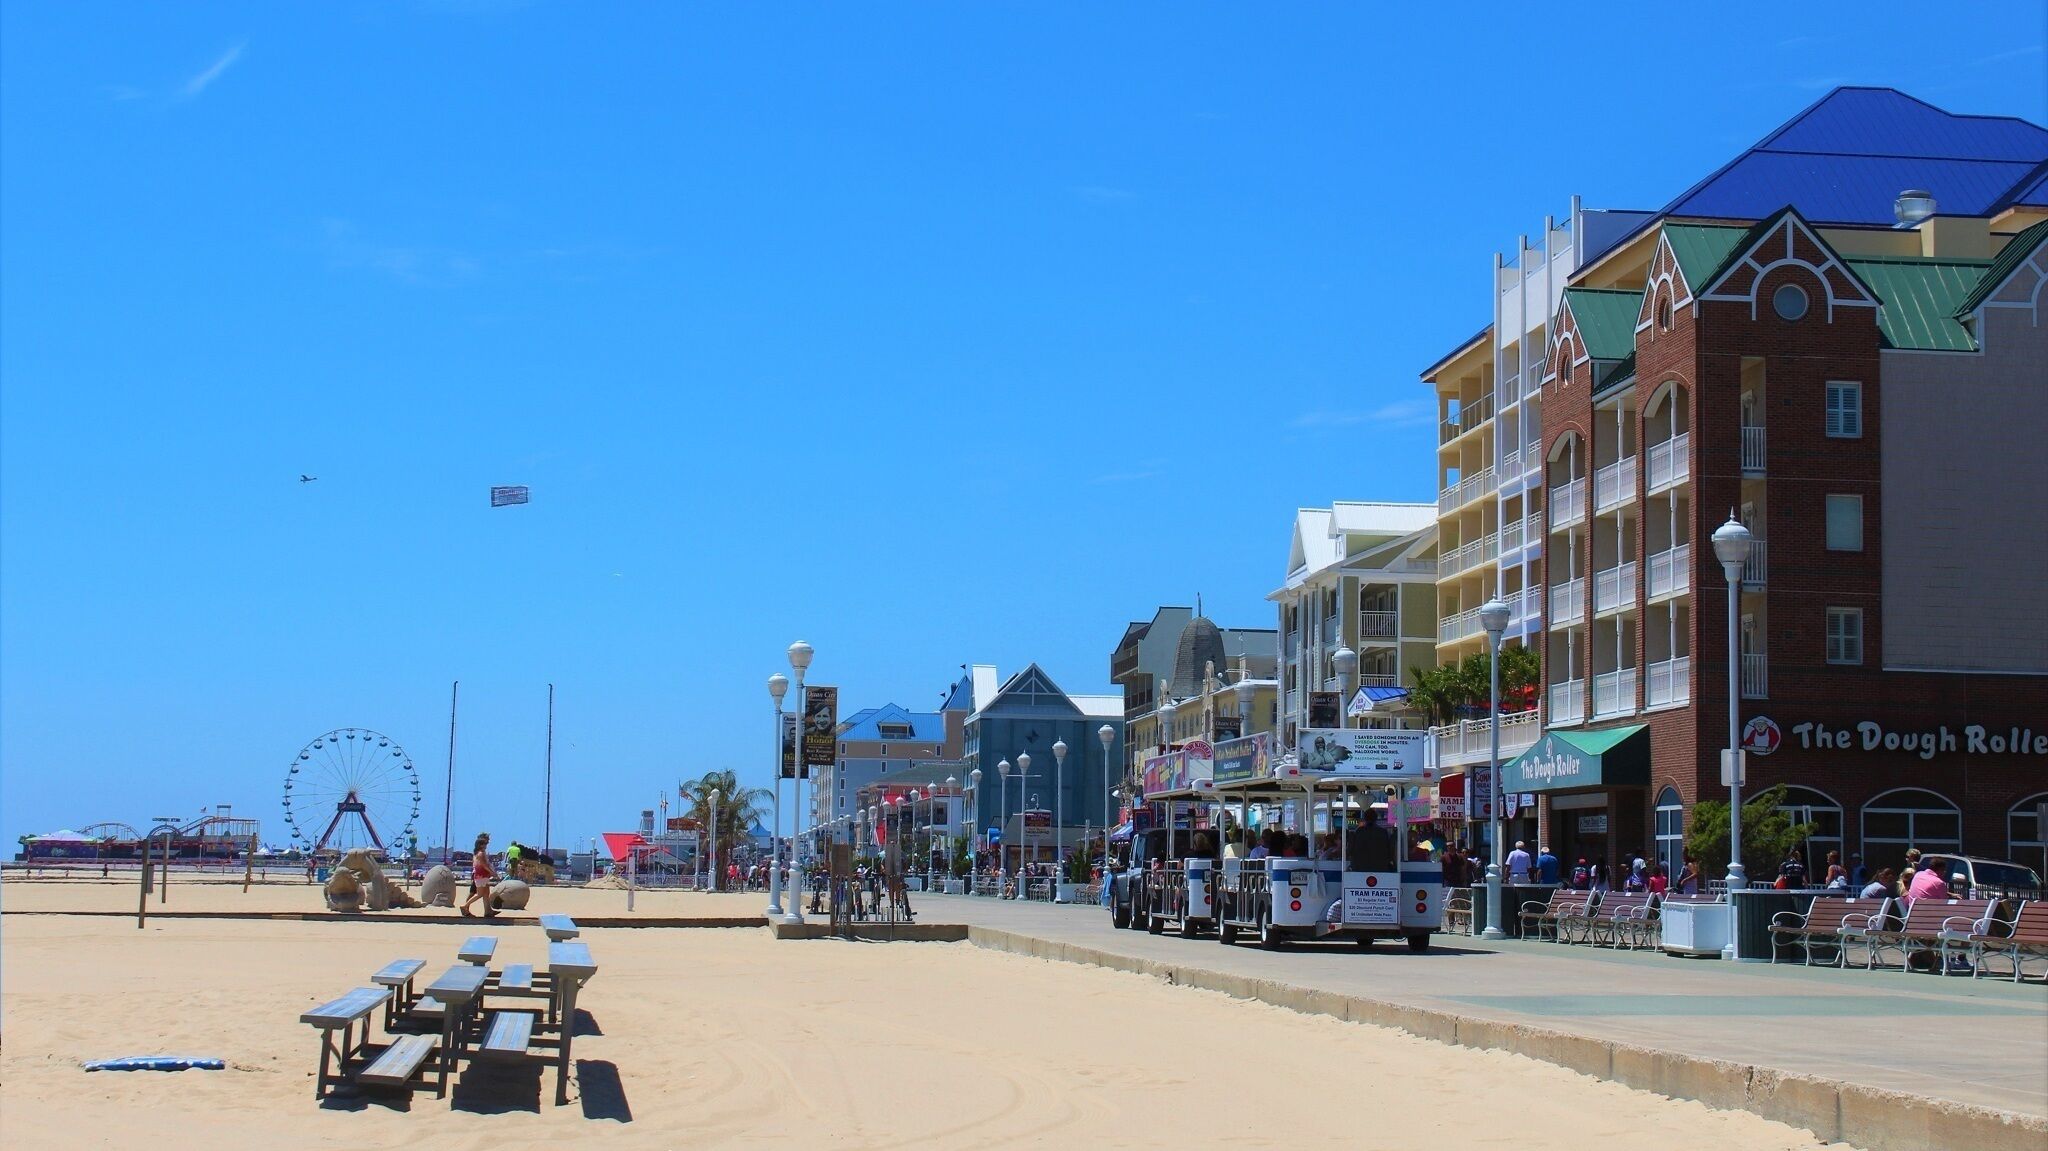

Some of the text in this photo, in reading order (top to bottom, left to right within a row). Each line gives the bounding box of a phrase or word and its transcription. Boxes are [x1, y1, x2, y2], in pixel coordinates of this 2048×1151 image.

[824, 691, 836, 699] City
[806, 735, 834, 744] Honor
[1792, 720, 2048, 760] The Dough Rolle
[1521, 753, 1580, 784] The Dough Roller
[1440, 797, 1465, 805] NAME
